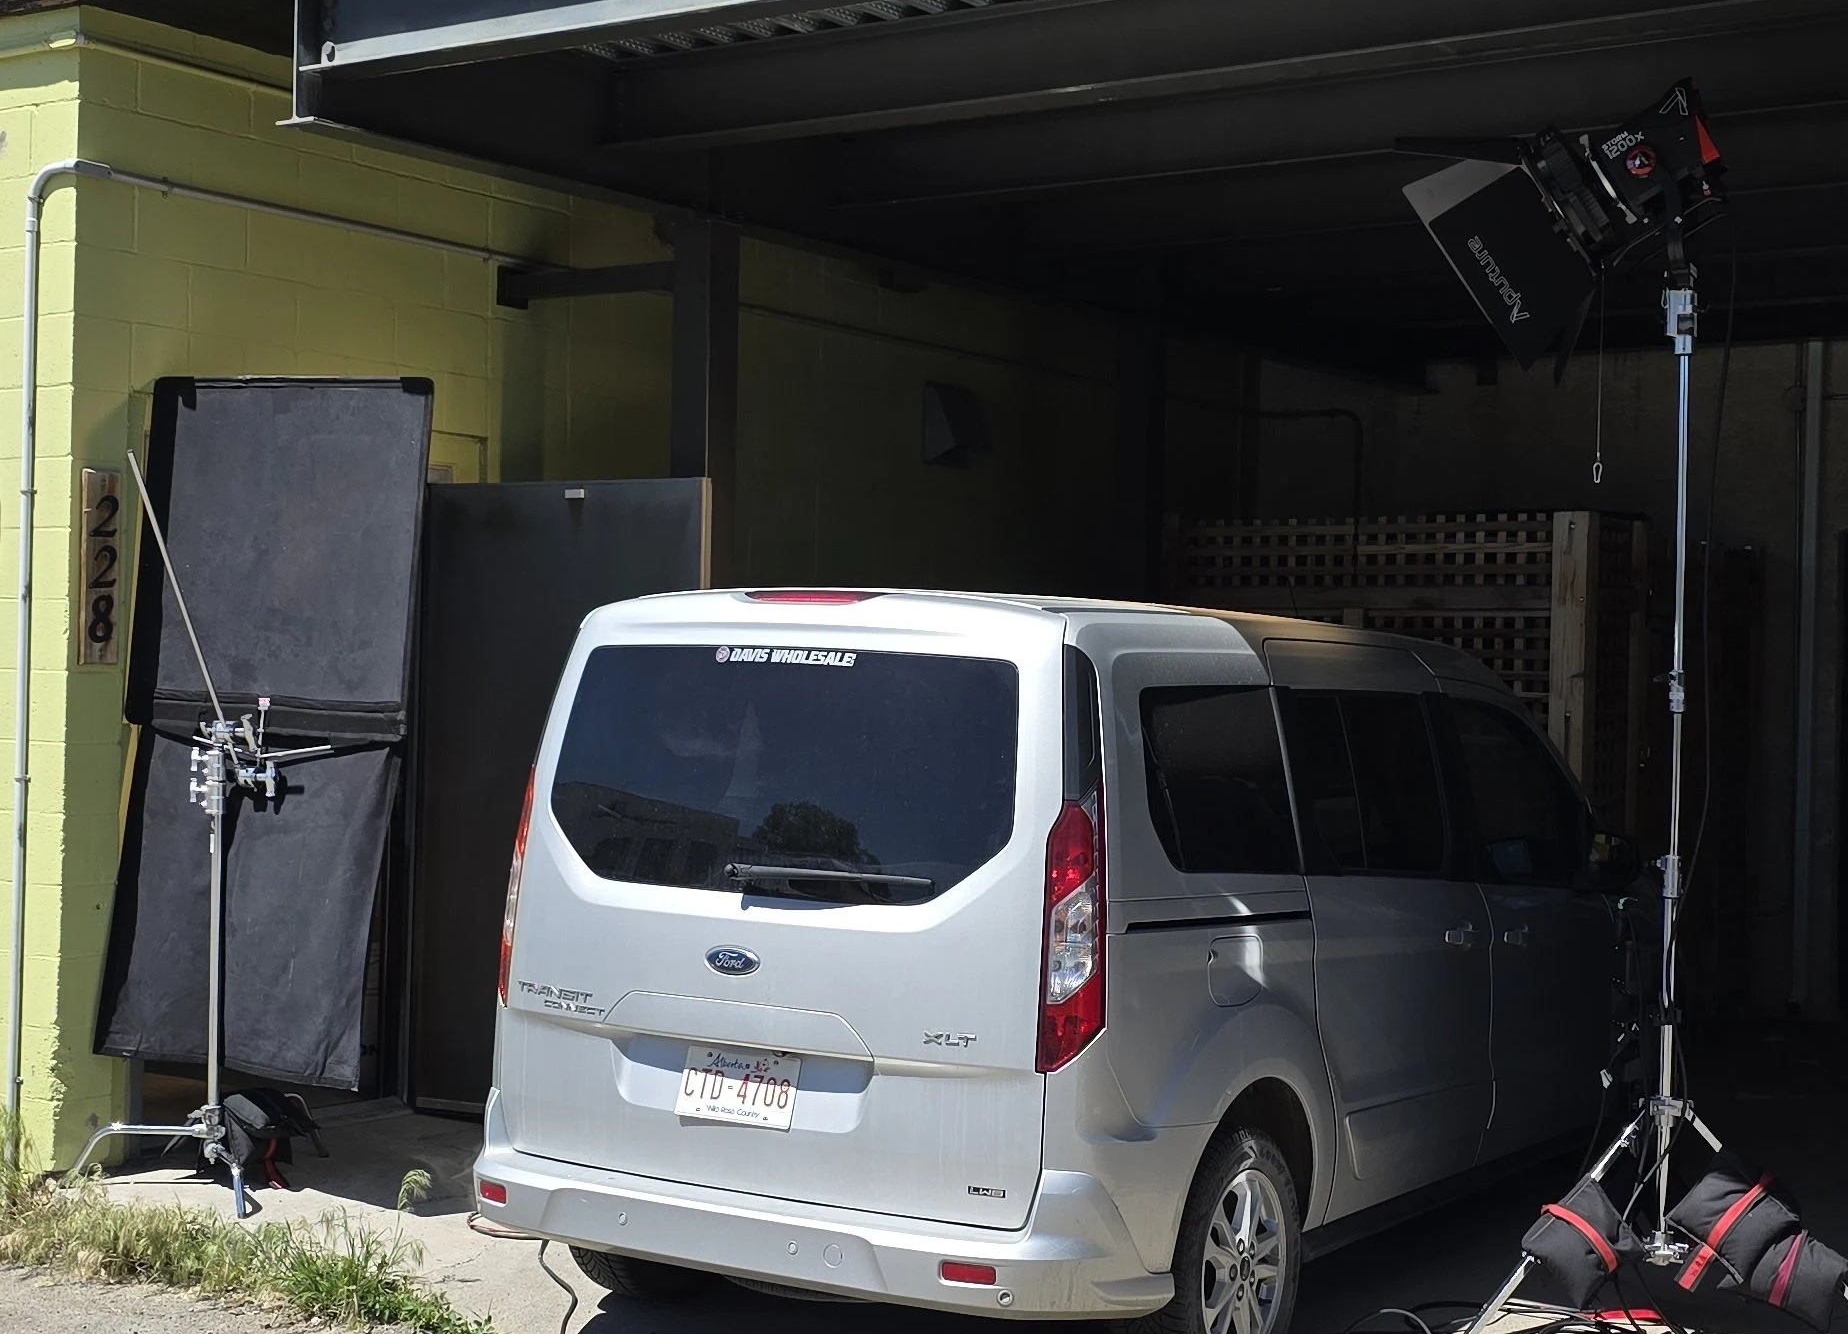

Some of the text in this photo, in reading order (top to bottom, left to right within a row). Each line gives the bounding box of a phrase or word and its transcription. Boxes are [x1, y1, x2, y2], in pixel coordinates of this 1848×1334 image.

[1602, 131, 1628, 152] STORM
[1467, 235, 1530, 323] Aputure
[88, 494, 119, 643] 228
[729, 648, 857, 667] DAVIS WHOLESALE
[715, 951, 746, 969] Ford
[518, 979, 594, 1003] TRANSIT
[543, 999, 605, 1017] CONNECT
[923, 1030, 977, 1048] XLT
